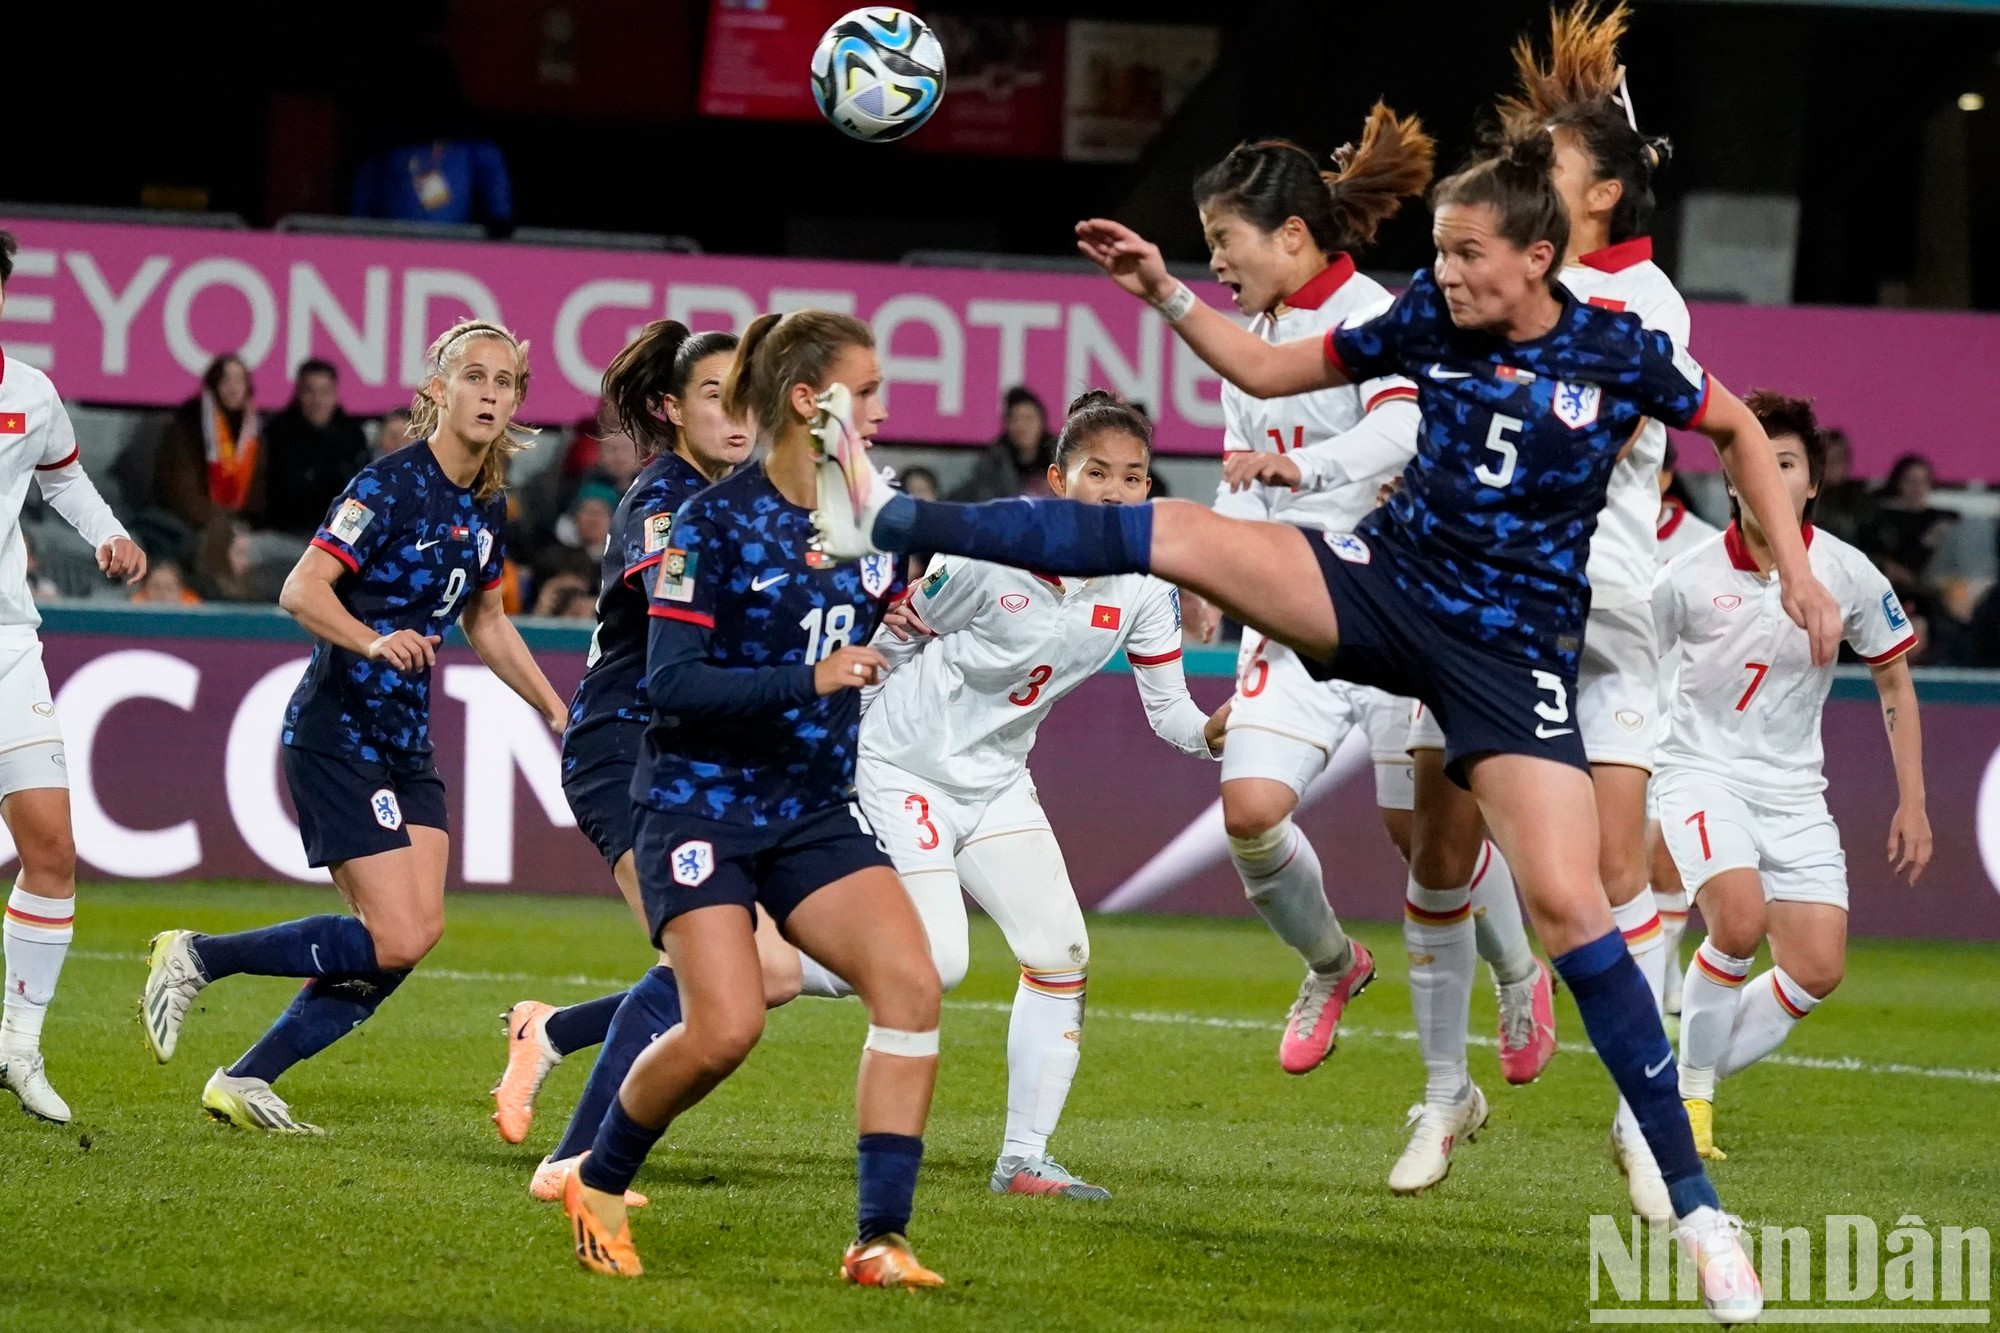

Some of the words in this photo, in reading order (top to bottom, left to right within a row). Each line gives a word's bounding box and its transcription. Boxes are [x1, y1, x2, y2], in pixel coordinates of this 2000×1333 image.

[1474, 412, 1523, 488] 5
[432, 568, 466, 617] 9
[799, 604, 855, 666] 18
[1008, 664, 1053, 707] 3
[1735, 662, 1769, 712] 7
[904, 794, 939, 850] 3
[1684, 811, 1712, 861] 7
